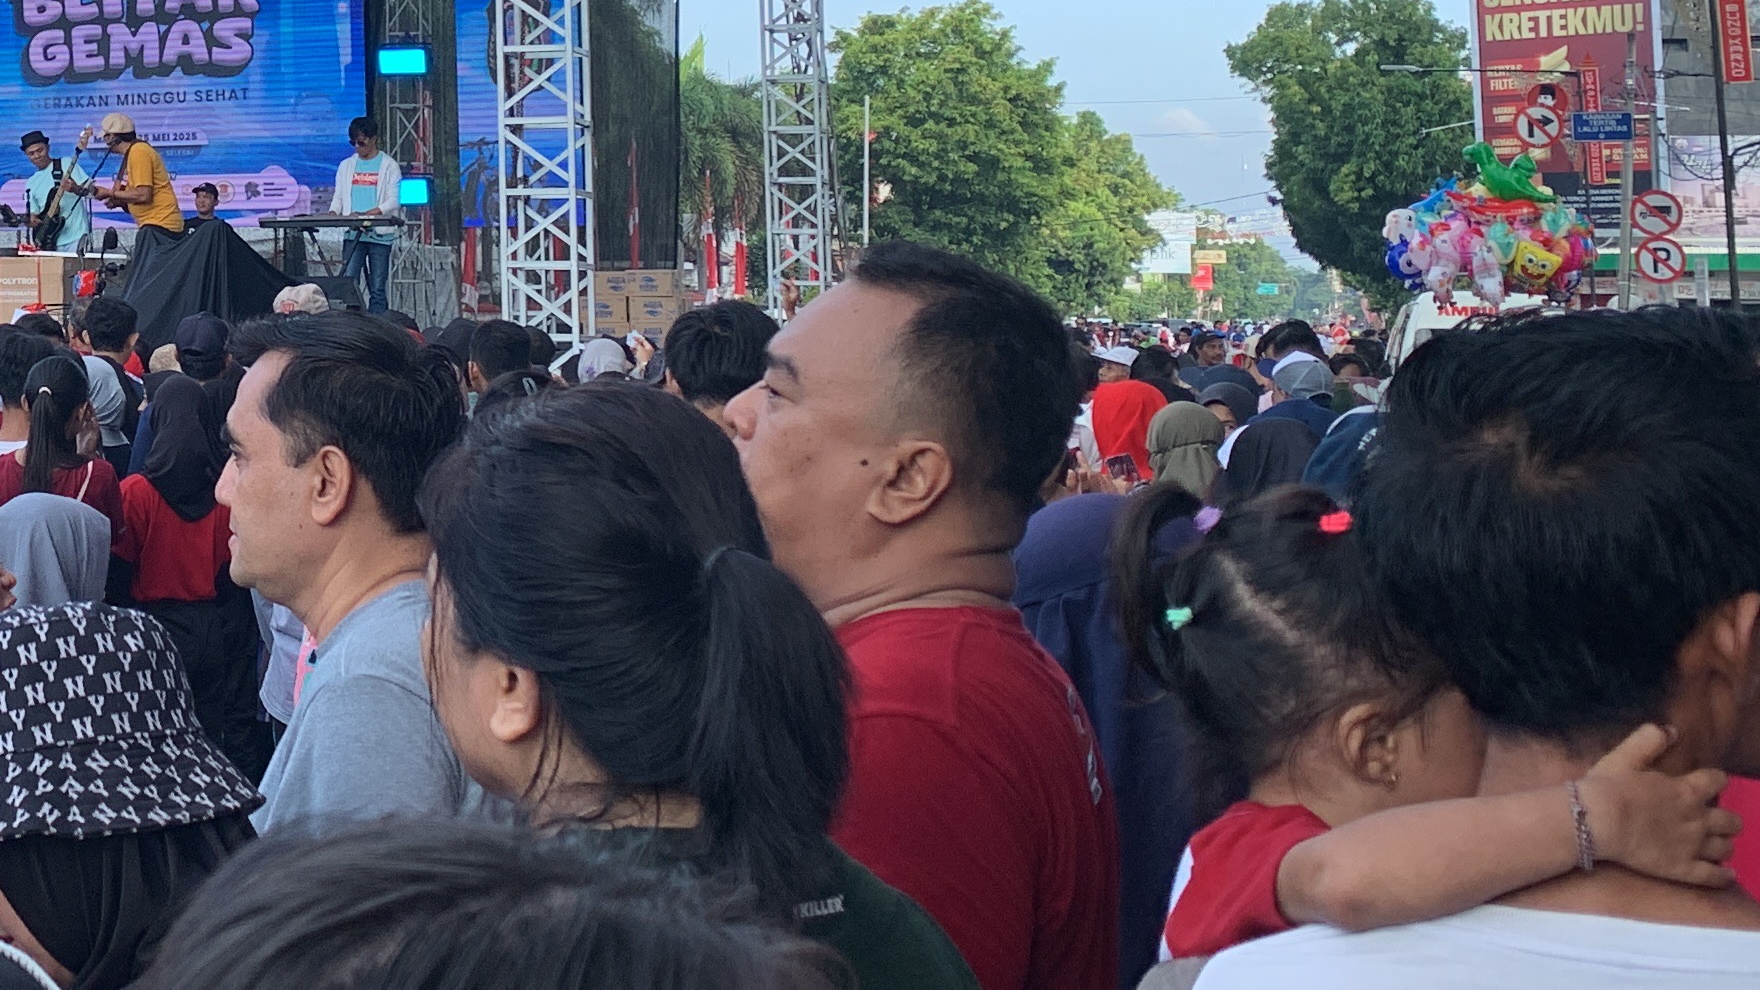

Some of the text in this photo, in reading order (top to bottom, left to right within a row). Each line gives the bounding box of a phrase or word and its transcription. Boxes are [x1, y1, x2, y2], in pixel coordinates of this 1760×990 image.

[1485, 3, 1645, 42] KRETEKMU!
[28, 17, 254, 77] GEMAS
[116, 91, 187, 106] MINGGU
[194, 87, 249, 103] SEHAT
[152, 133, 170, 142] MEI
[172, 132, 197, 141] 2025
